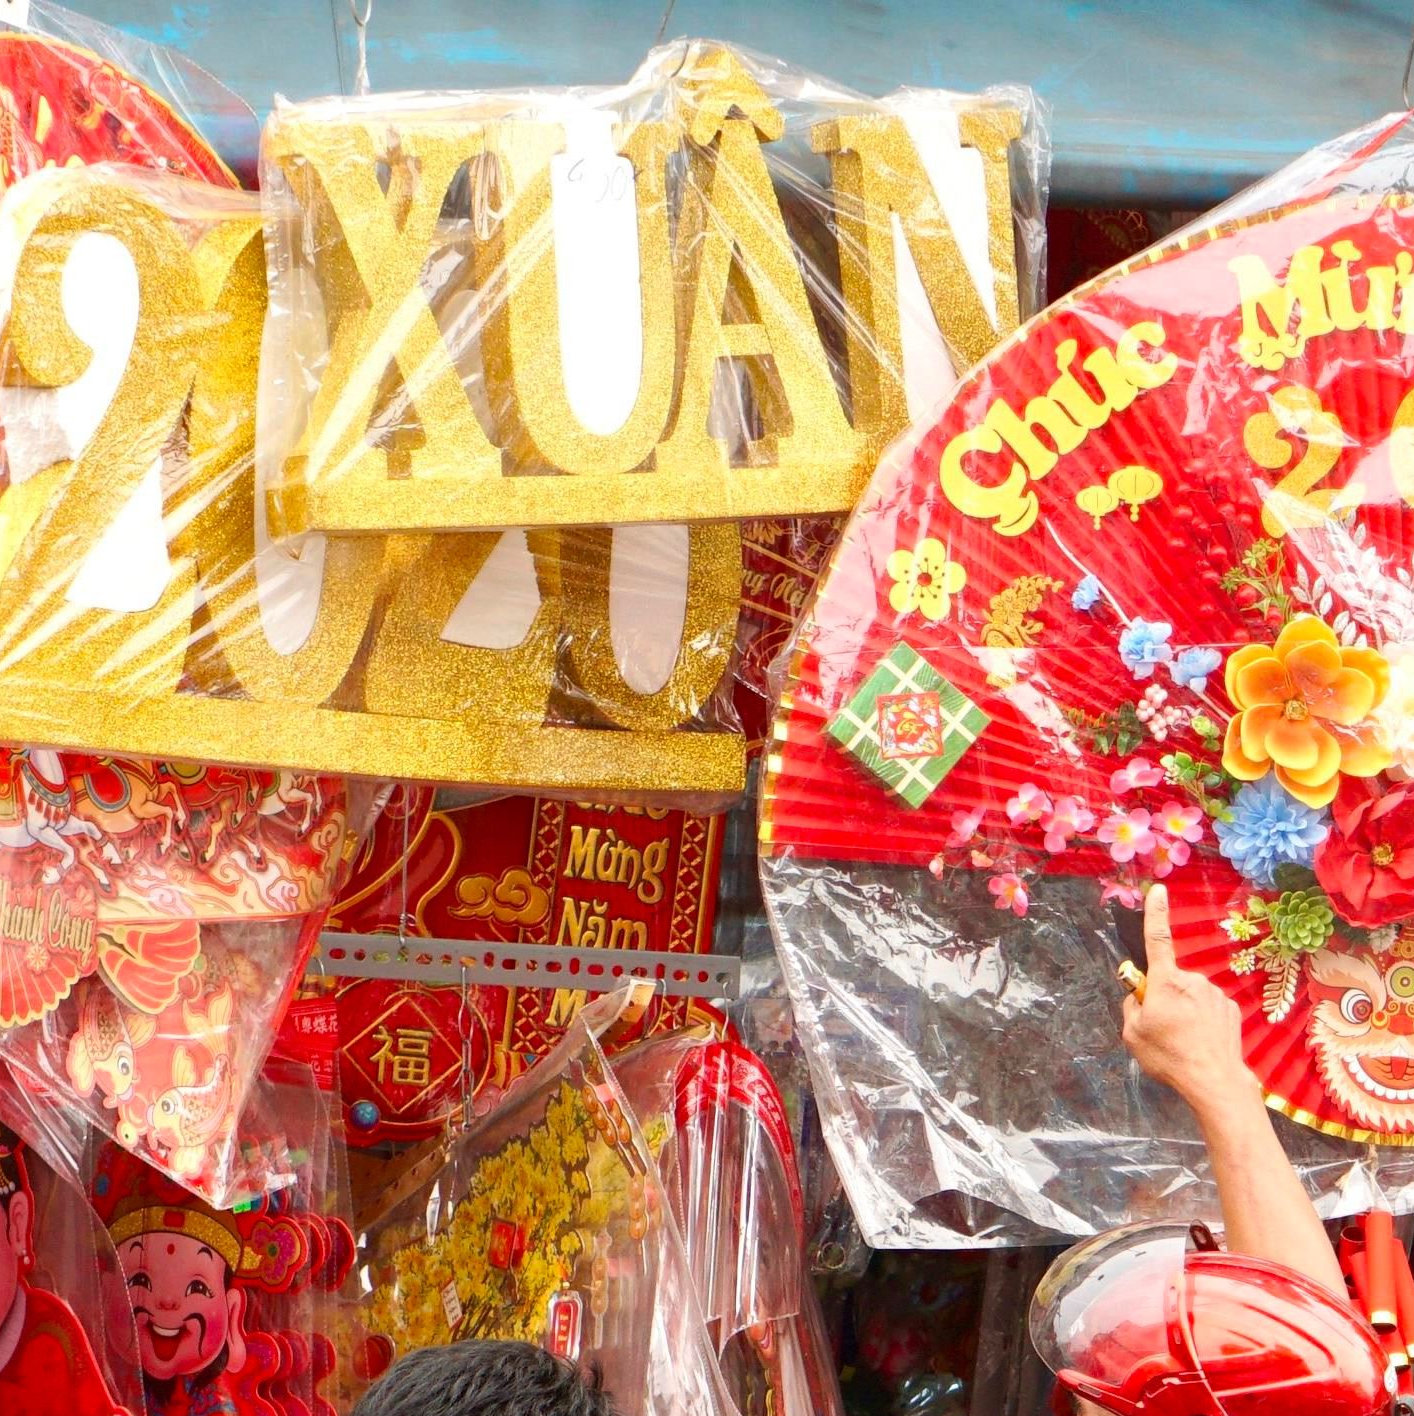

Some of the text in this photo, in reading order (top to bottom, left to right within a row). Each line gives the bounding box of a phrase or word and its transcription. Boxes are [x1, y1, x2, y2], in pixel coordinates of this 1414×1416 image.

[265, 46, 1024, 478] XUÂN
[939, 316, 1179, 538] Chúc
[562, 824, 671, 906] Mừng
[370, 1023, 435, 1088] 福
